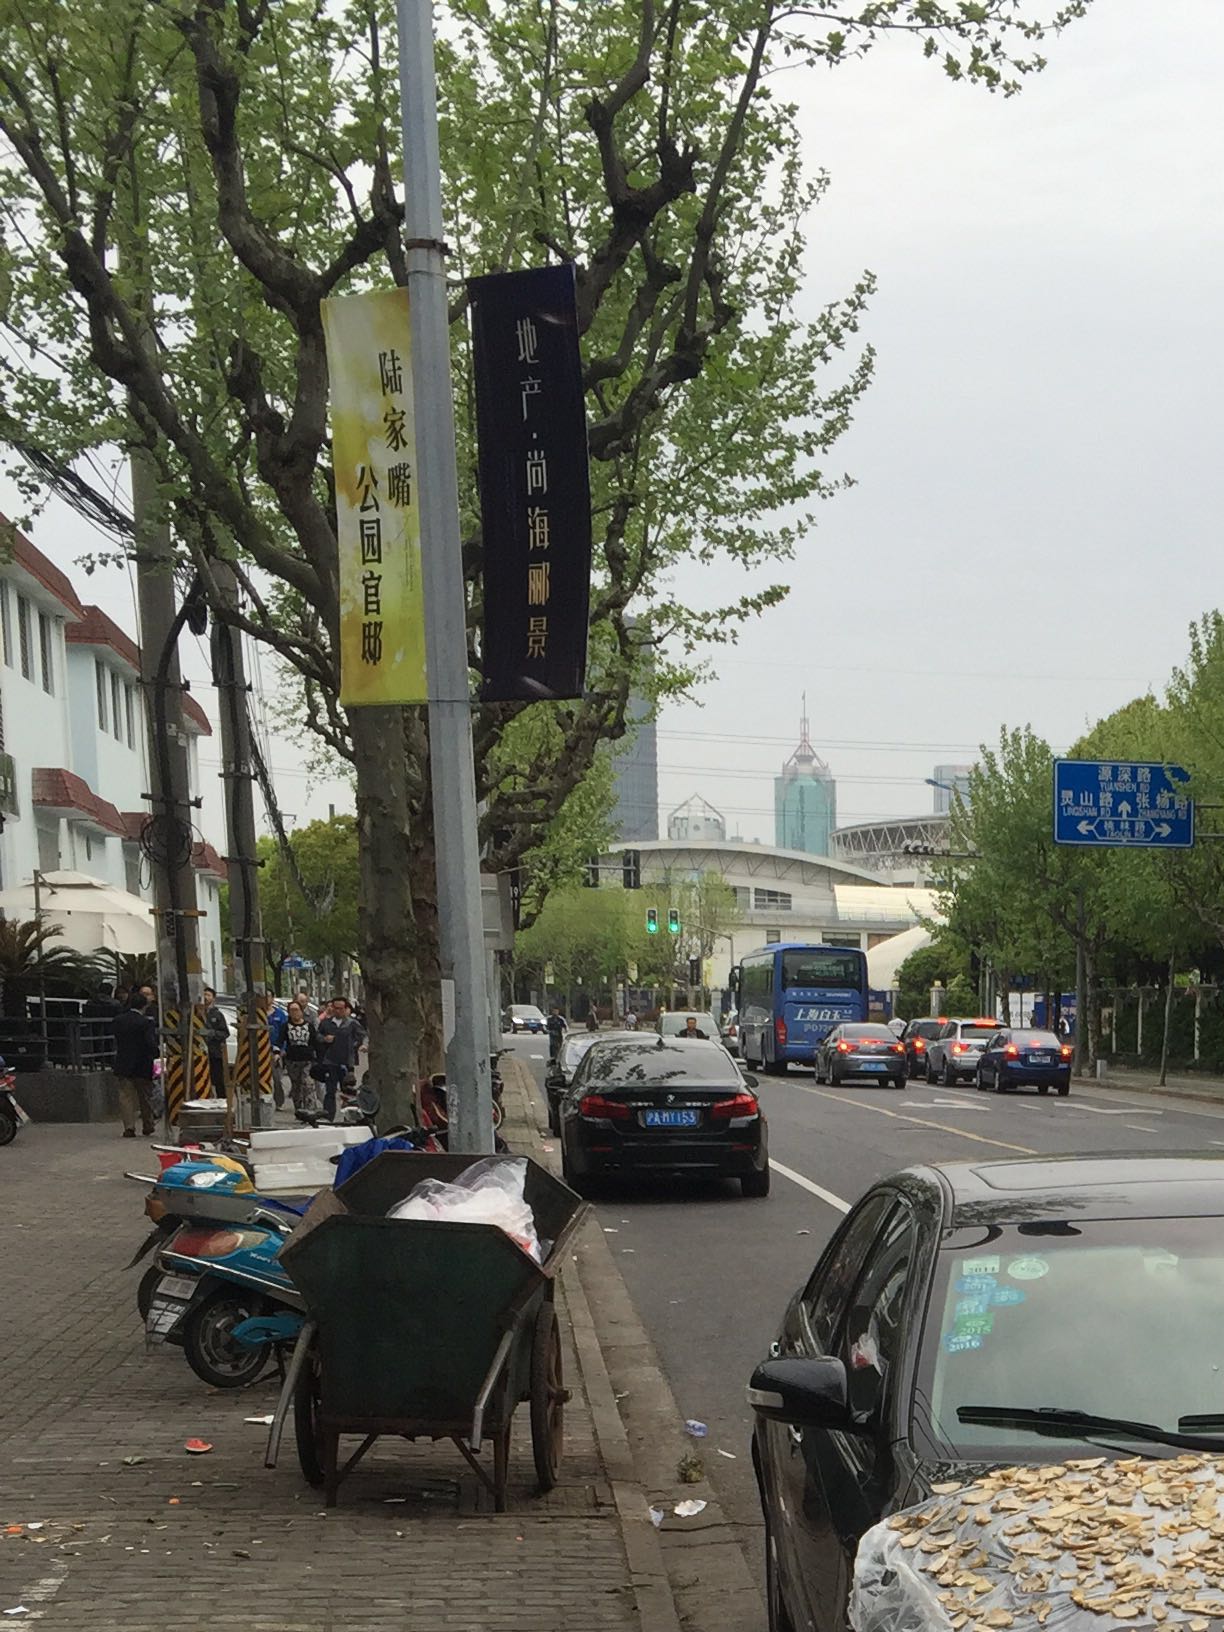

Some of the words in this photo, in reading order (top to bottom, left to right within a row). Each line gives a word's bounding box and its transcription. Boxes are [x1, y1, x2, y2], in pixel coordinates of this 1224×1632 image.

[378, 348, 411, 509] 陆家嘴
[355, 464, 384, 667] 公园官邸
[1060, 790, 1113, 807] 灵山路
[1098, 766, 1151, 782] 源深路
